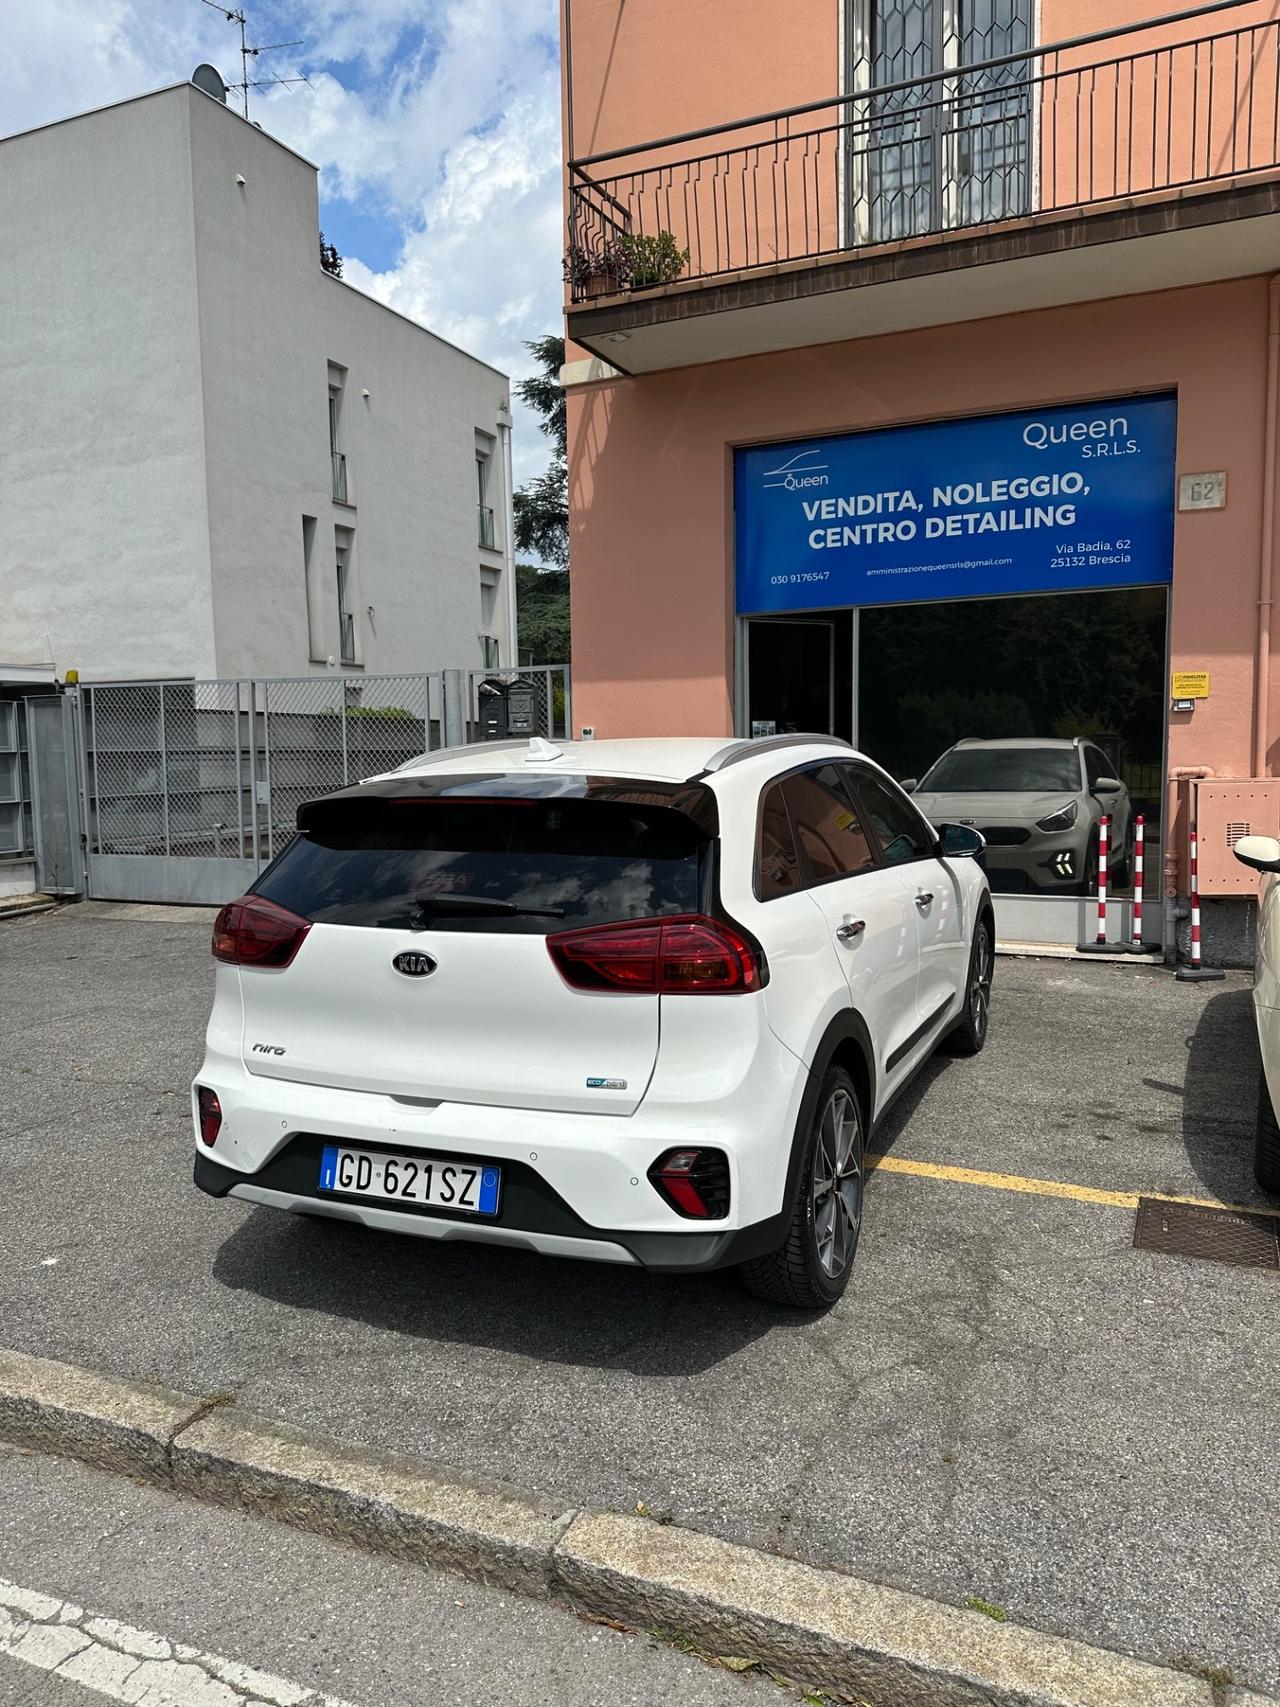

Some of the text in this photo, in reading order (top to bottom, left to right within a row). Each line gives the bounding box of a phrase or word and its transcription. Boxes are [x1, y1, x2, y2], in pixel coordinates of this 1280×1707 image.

[1023, 417, 1128, 450] Queen
[1081, 439, 1141, 459] S.R.L.S.
[784, 475, 828, 490] Queen
[802, 472, 1090, 521] VENDITA, NOLEGGIO,
[808, 504, 1077, 550] CENTRO DETAILING
[1055, 539, 1131, 554] Via Badia, 62
[770, 557, 1013, 585] 030 9176547 amministrazionequeensrls@gmail.com
[1050, 553, 1131, 568] 25132 Brescia
[398, 956, 430, 972] KIA
[339, 1153, 372, 1190] GD
[383, 1159, 477, 1206] 621SZ
